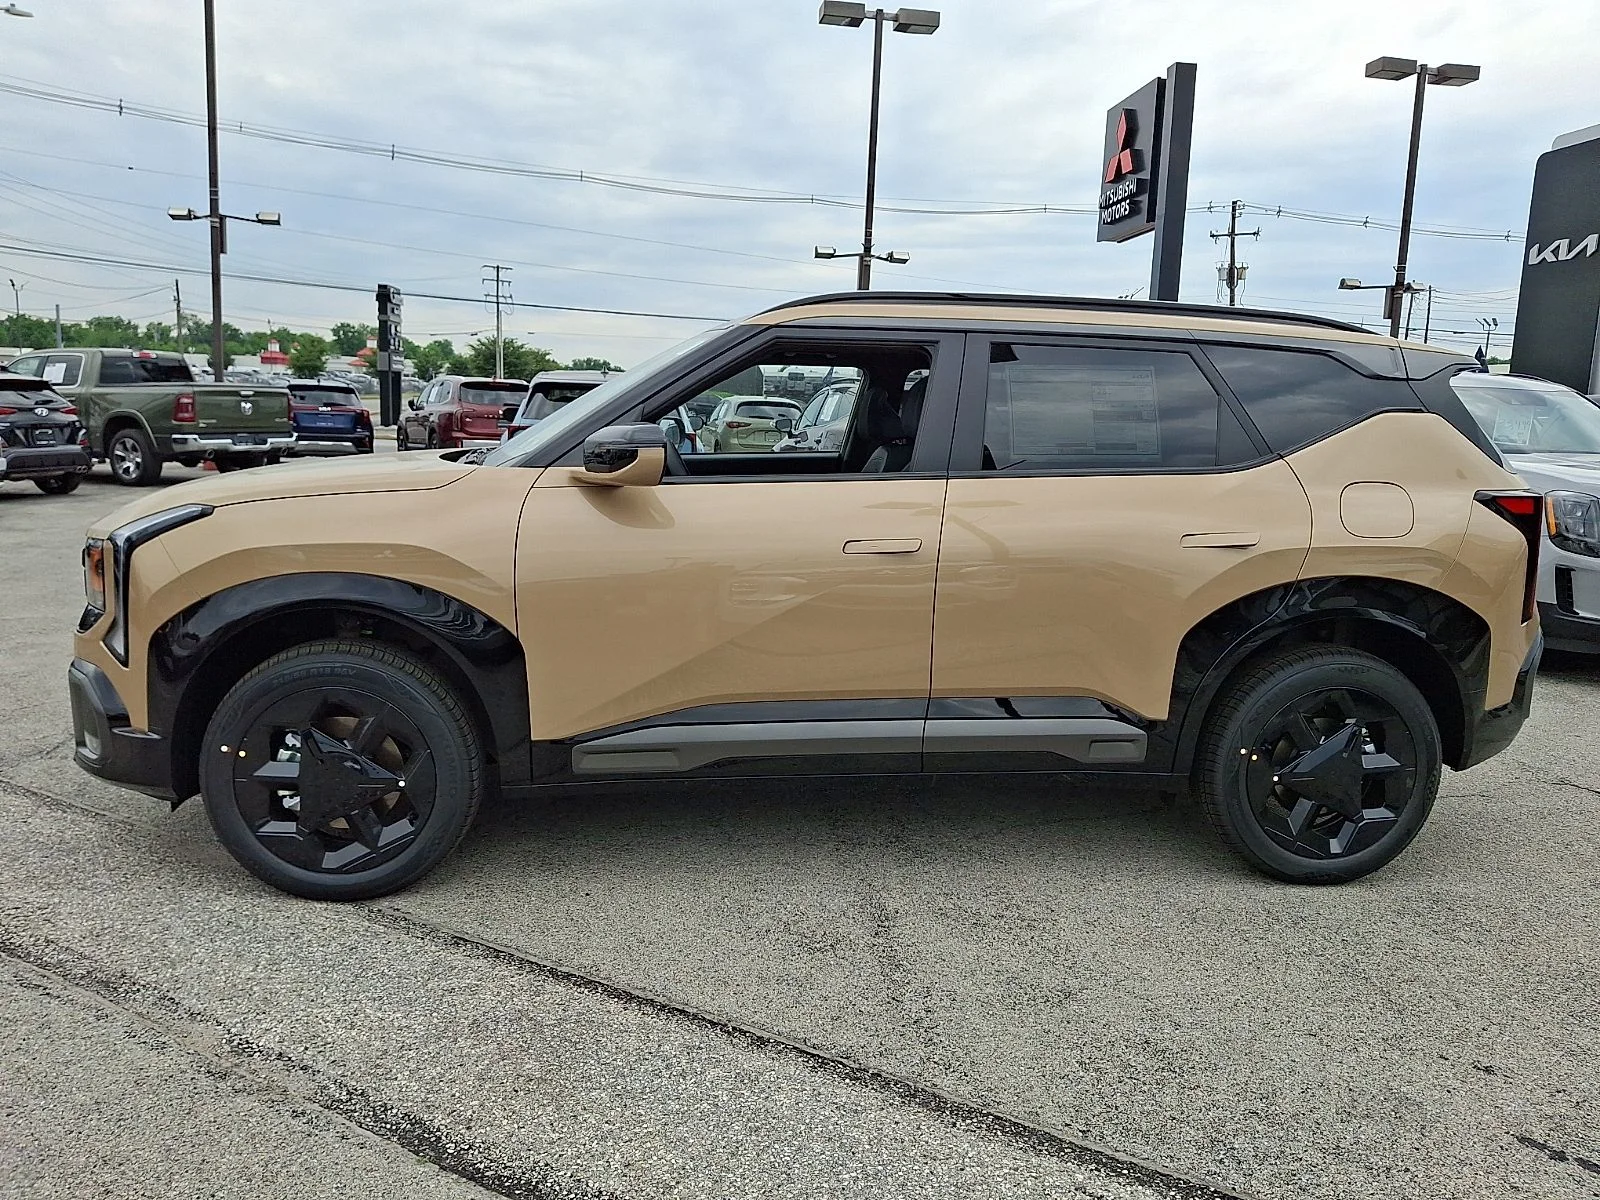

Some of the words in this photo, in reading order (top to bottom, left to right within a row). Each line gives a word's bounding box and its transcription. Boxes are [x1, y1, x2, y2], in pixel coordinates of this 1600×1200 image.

[1099, 177, 1137, 206] MITSUBISHI
[1101, 199, 1130, 224] MOTORS
[1528, 233, 1600, 265] KIA
